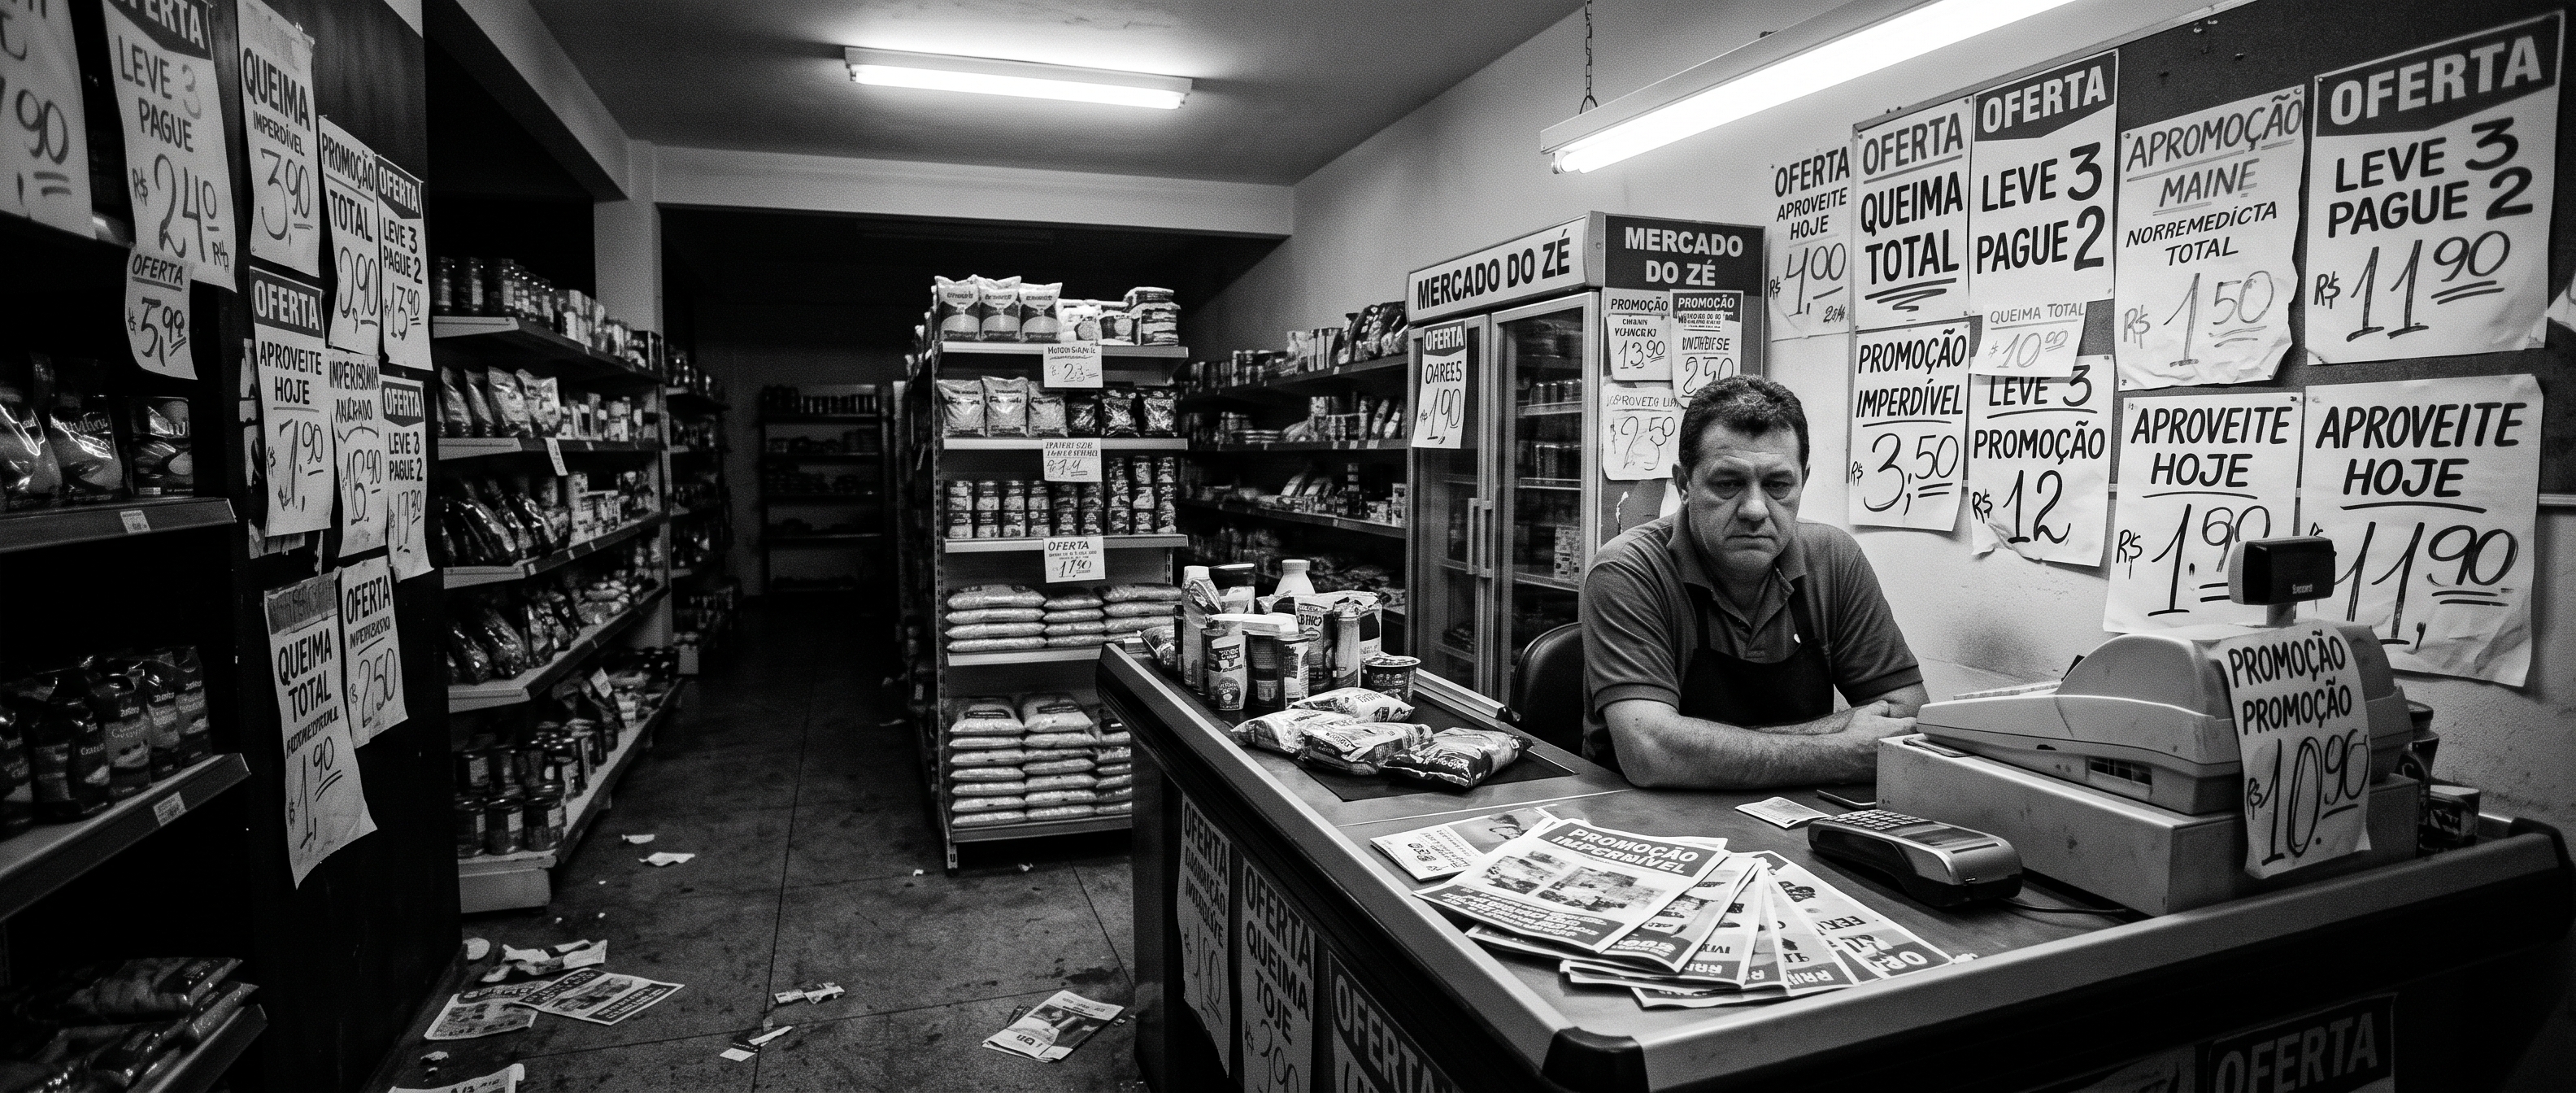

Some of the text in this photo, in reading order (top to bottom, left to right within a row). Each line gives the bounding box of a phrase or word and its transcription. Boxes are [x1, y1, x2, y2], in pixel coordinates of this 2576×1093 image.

[120, 0, 205, 49] ERTA
[119, 35, 202, 120] LEVE 3
[243, 47, 311, 133] QUEIMA
[1982, 65, 2106, 133] OFERTA
[2330, 35, 2543, 126] OFERTA
[138, 97, 194, 153] PAGUE
[1863, 112, 1963, 175] OFERTA
[2126, 93, 2303, 173] APROMOÇÃO
[322, 133, 375, 192] PROMOÇÃO
[1775, 146, 1850, 198] OFERTA
[1982, 142, 2103, 212] LEVE 3
[2335, 115, 2519, 194] LEVE 3
[379, 166, 420, 214] OFERTA
[1777, 187, 1847, 222] APROVEITE
[1860, 171, 1964, 237] QUEIMA
[2328, 166, 2534, 238] PAGUE 2
[329, 189, 372, 243] TOTAL
[383, 217, 417, 255] LEVE 3
[1790, 215, 1829, 240] HOJE
[1977, 204, 2105, 275] PAGUE 2
[383, 245, 423, 284] PAGUE 2
[1625, 227, 1743, 257] MERCADO
[1865, 229, 1960, 285] TOTAL
[2165, 236, 2239, 266] TOTAL
[133, 254, 183, 285] OFERTA
[1417, 229, 1570, 311] MERCADO DO ZÉ
[1646, 259, 1716, 286] DO ZÉ
[1769, 276, 1781, 300] R$
[2314, 271, 2342, 310] R$
[254, 280, 320, 331] OFERTA
[1611, 296, 1668, 312] PROMOÇÃO
[1677, 294, 1734, 311] PROMOÇÃO
[1991, 303, 2084, 324] QUEIMA TOTAL
[1425, 325, 1464, 351] OFERTA
[2123, 305, 2151, 349] R$
[259, 341, 322, 376] APROVEITE
[1859, 328, 1967, 375] PROMOÇÃO
[275, 376, 311, 405] HOJE
[385, 388, 421, 417] OFERTA
[1856, 378, 1963, 418] IMPERDÍVEL
[1989, 364, 2092, 407] LEVE 3
[389, 433, 411, 455] LEVE
[1973, 420, 2105, 465] PROMOÇÃO
[2130, 406, 2293, 445] APROVEITE
[2315, 402, 2528, 449] APROVEITE
[389, 458, 423, 481] PAGUE 2
[1850, 461, 1864, 486] R$
[2151, 452, 2253, 488] HOJE
[2343, 458, 2470, 499] HOJE
[1972, 489, 1993, 525] R$
[1048, 541, 1089, 551] OFERTA
[2116, 529, 2143, 580] R$
[346, 574, 391, 625] OFERTA
[277, 628, 332, 687] QUEIMA
[2227, 629, 2346, 689] PROMOÇÃO
[288, 668, 332, 723] TOTAL
[2243, 676, 2352, 735] PROMOÇÃO
[1184, 800, 1228, 886] OFERTA
[1568, 829, 1699, 862] PROMOÇÃO
[1245, 864, 1312, 981] OFERTA
[1246, 921, 1311, 1023] QUEIMA
[1255, 968, 1292, 1046] TOJE
[2215, 1012, 2378, 1093] OFERTA
